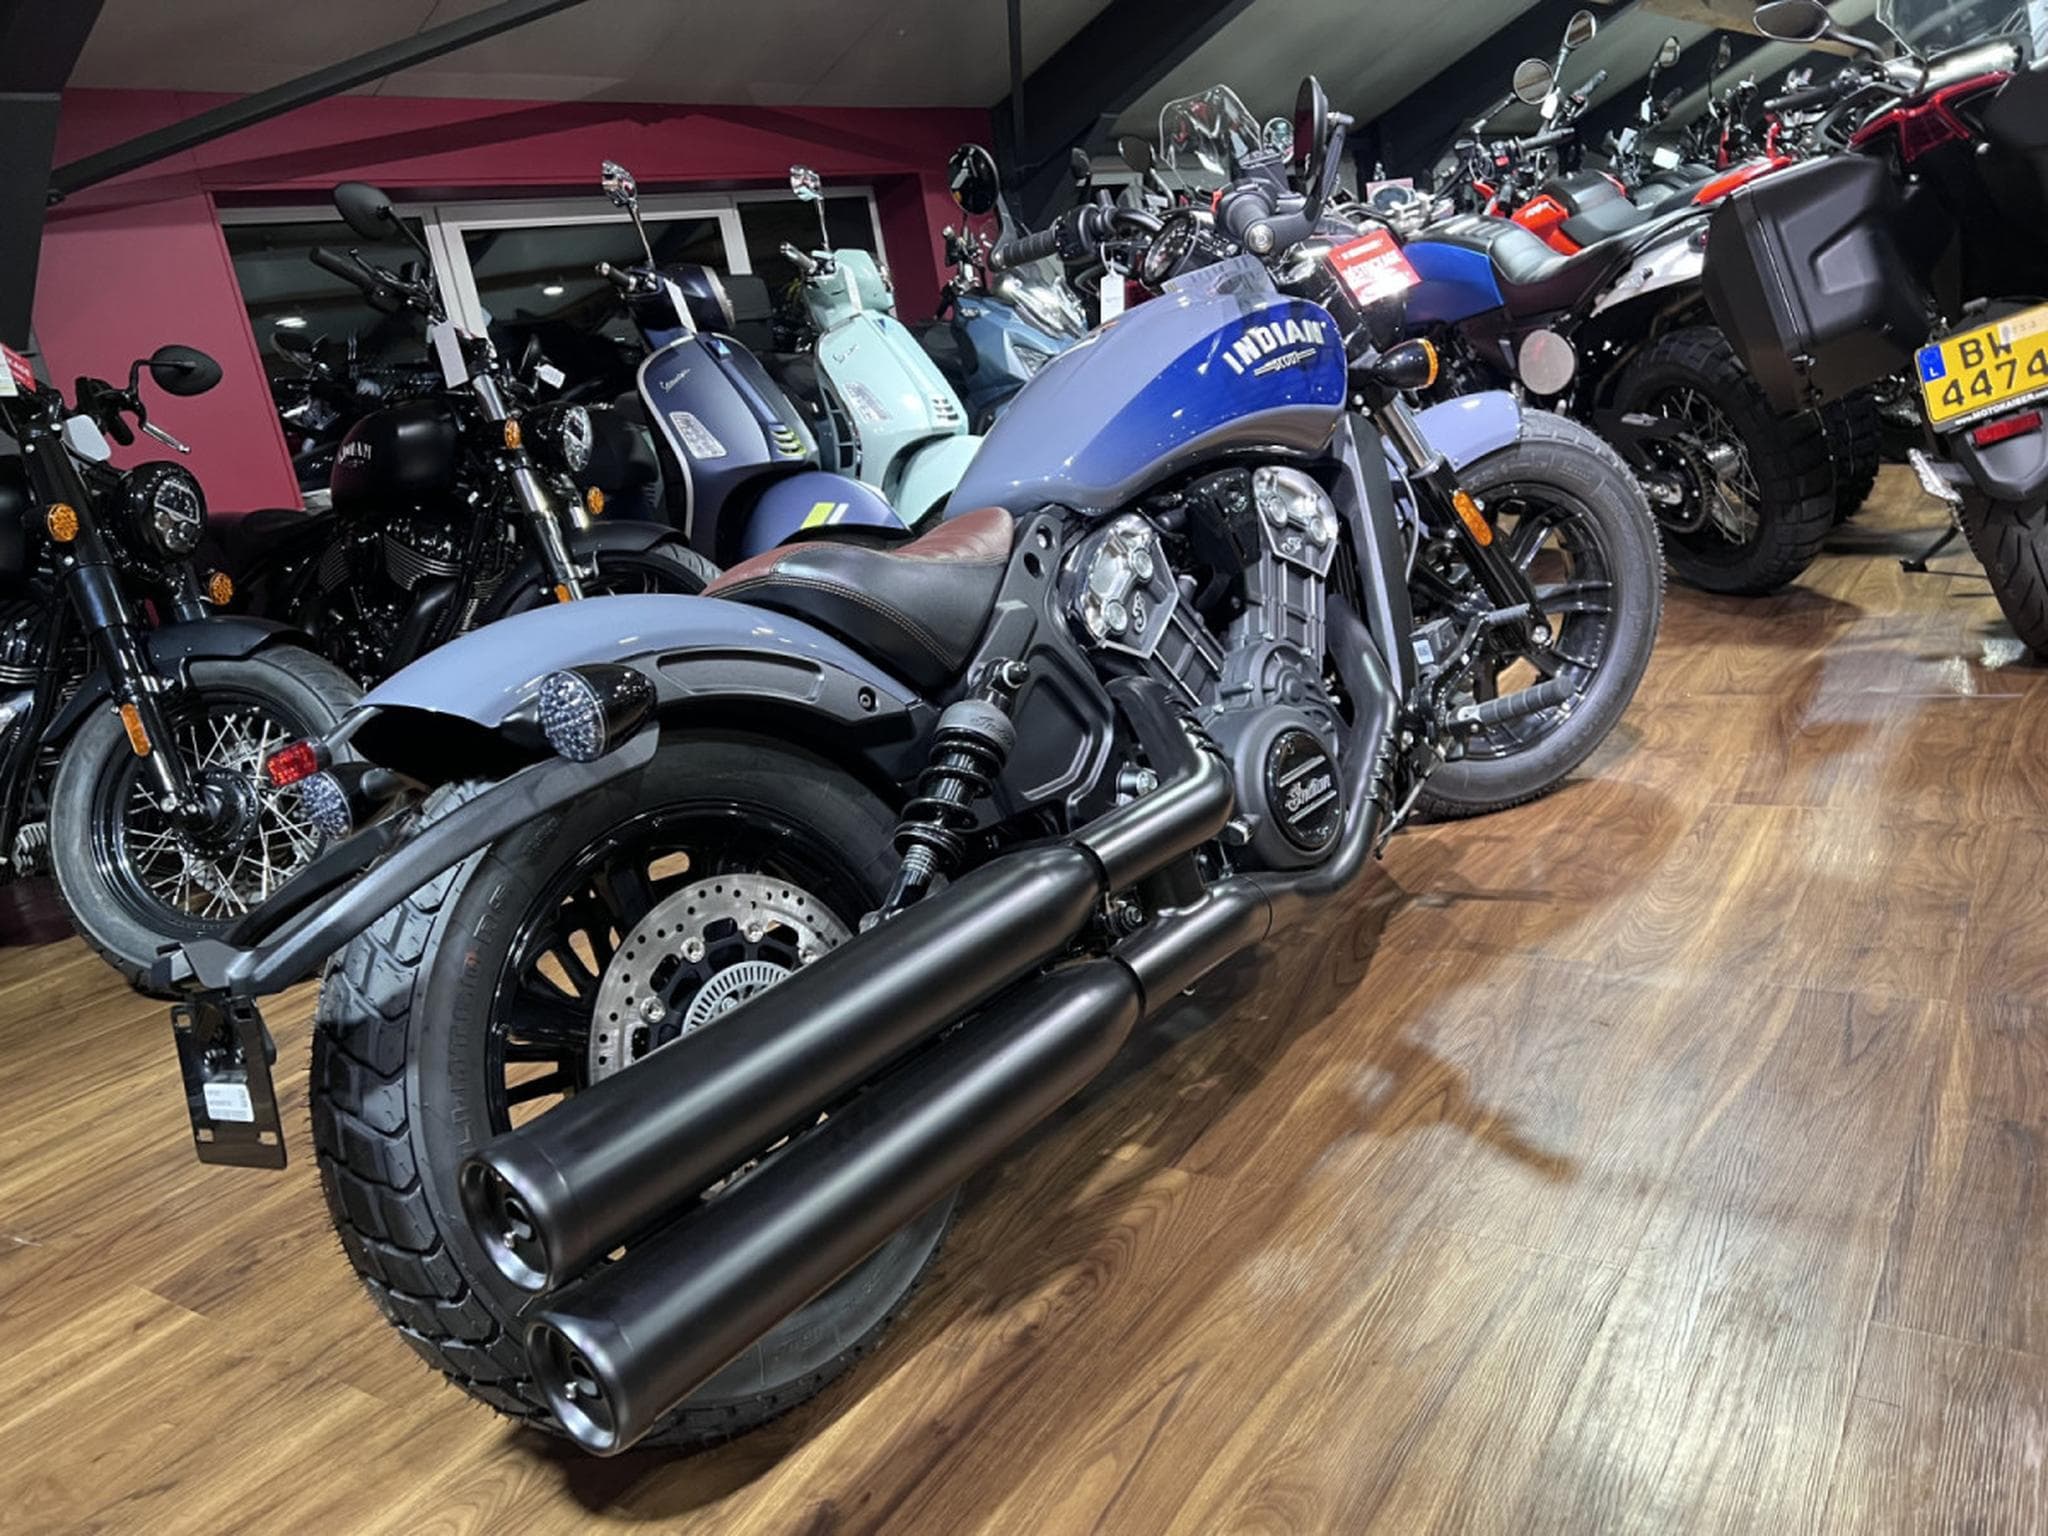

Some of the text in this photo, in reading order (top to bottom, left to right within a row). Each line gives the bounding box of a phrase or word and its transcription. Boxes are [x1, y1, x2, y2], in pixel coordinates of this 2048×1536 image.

[1222, 319, 1325, 375] INDIAN
[1929, 367, 1939, 378] L
[1942, 348, 2048, 407] 4474
